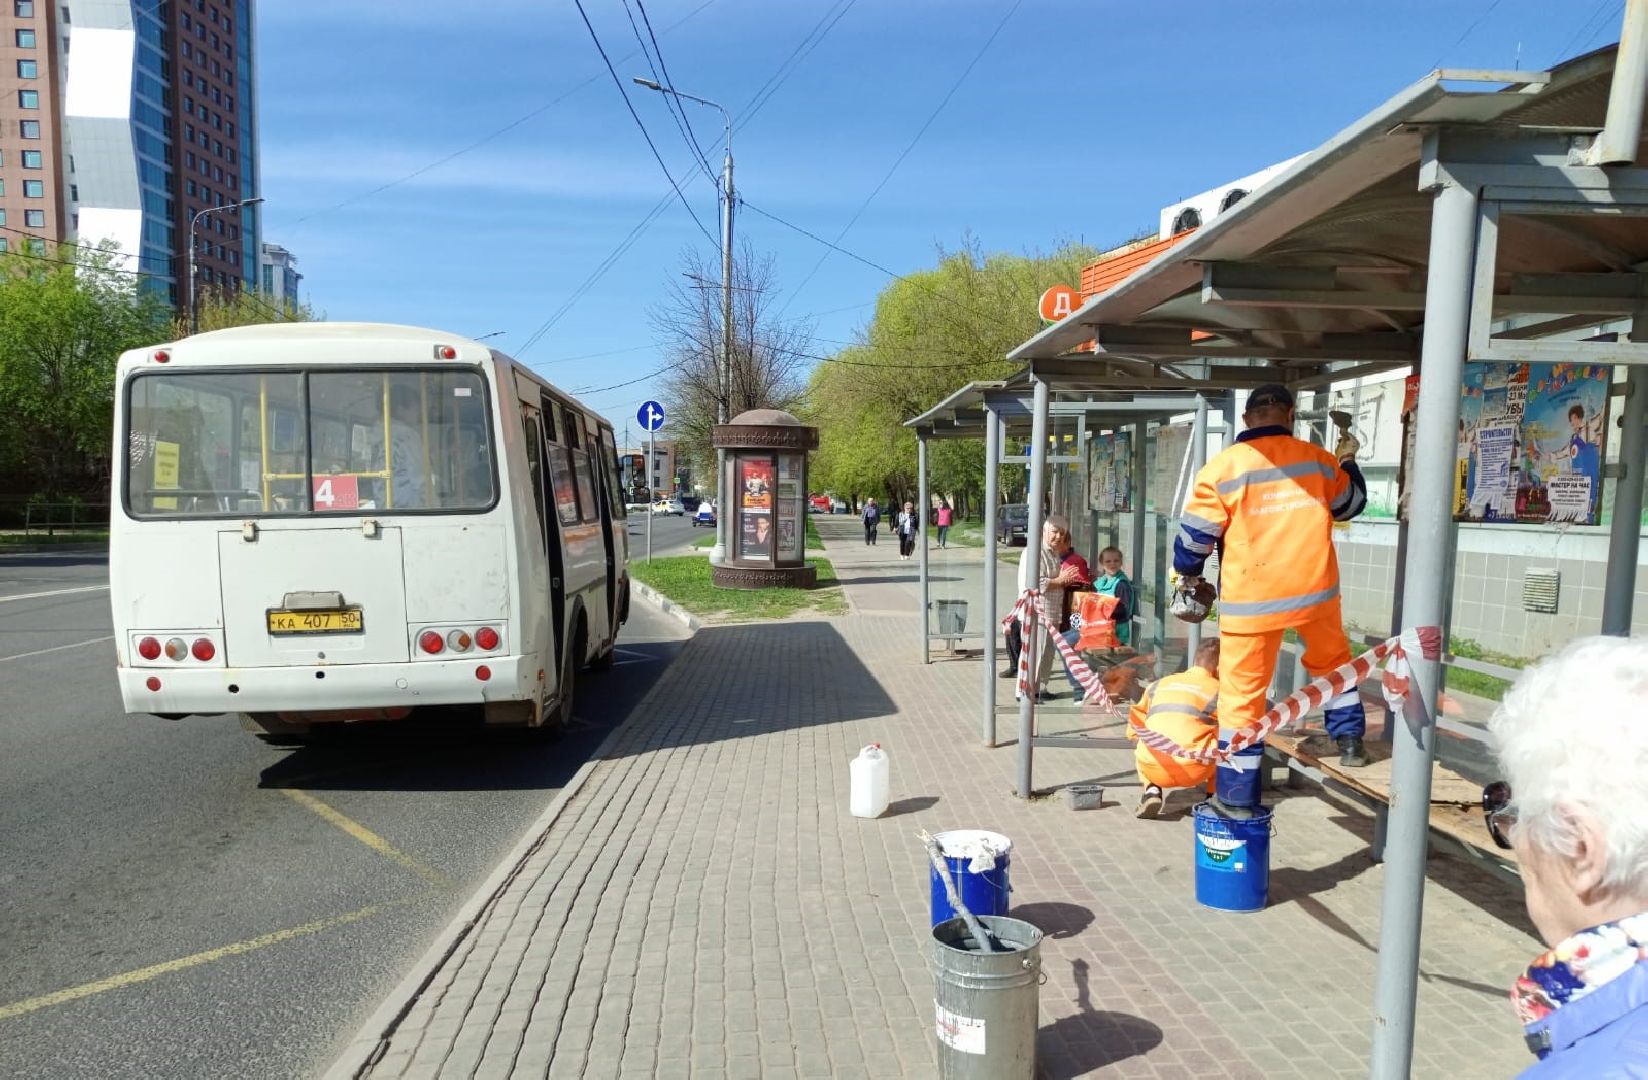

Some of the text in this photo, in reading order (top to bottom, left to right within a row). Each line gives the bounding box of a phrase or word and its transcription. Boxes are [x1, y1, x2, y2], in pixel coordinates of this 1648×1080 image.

[1053, 292, 1072, 317] Д
[314, 479, 335, 508] 4
[303, 613, 331, 628] 407
[341, 612, 356, 624] 50
